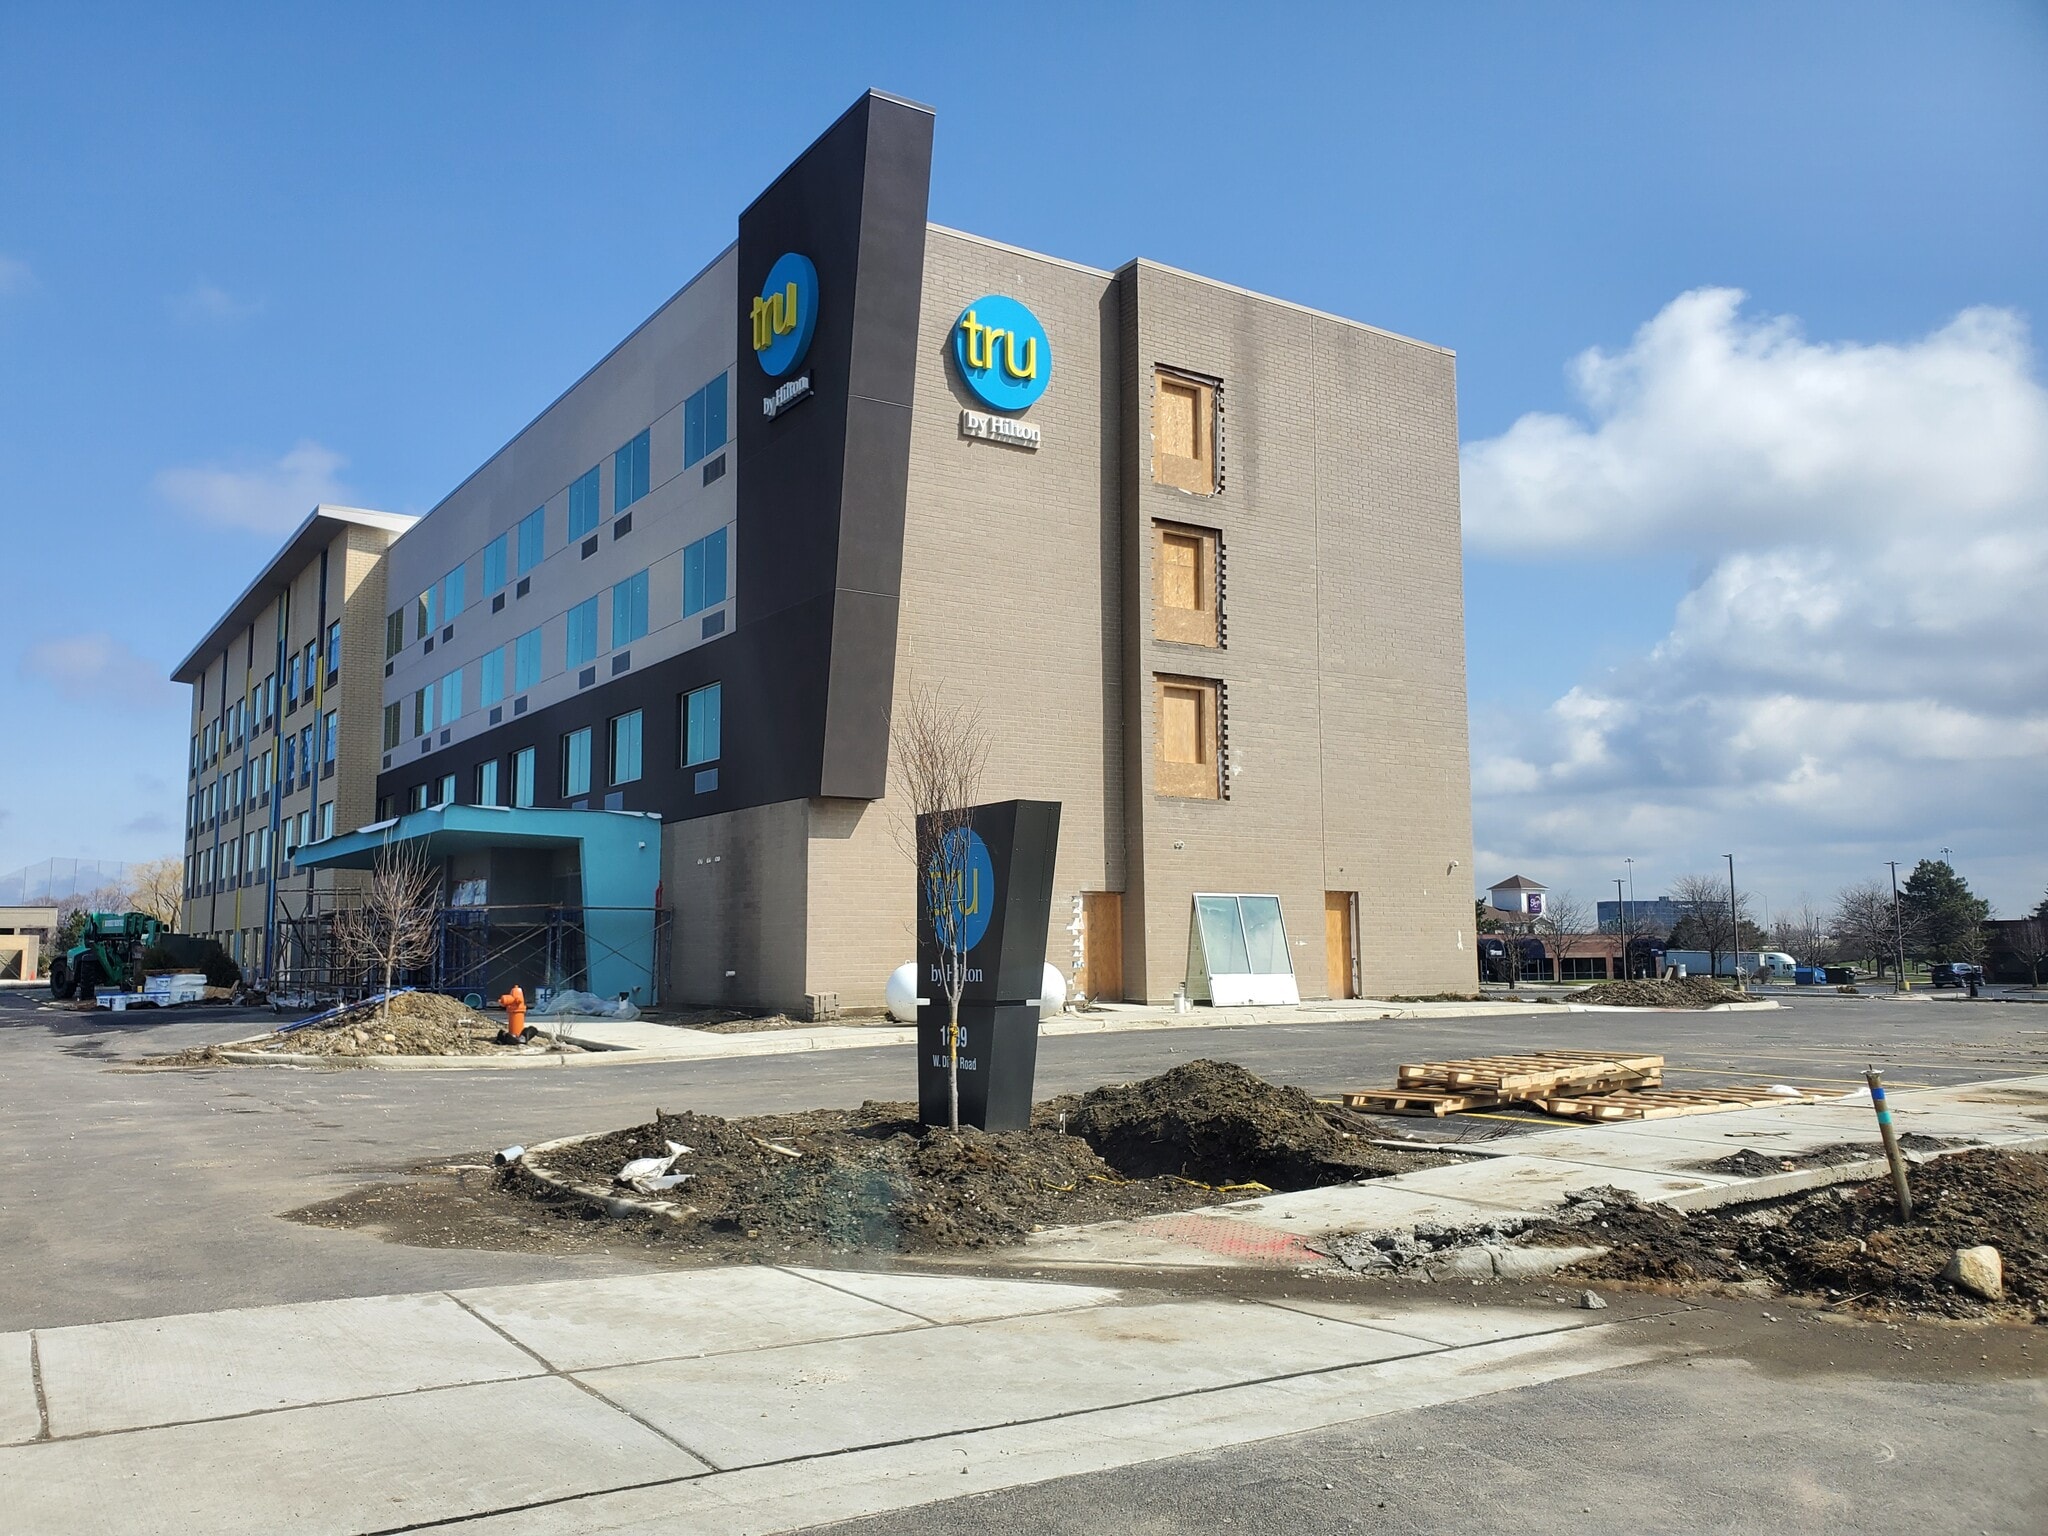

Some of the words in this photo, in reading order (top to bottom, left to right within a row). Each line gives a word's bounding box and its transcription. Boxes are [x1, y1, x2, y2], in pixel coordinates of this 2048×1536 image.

[750, 282, 797, 351] tru
[960, 310, 1036, 380] tru
[763, 397, 776, 416] by
[775, 376, 810, 407] Hilton
[967, 411, 988, 434] by
[990, 415, 1041, 441] Hilton
[931, 963, 943, 987] by
[932, 1054, 941, 1068] W.
[960, 1056, 977, 1070] Road
